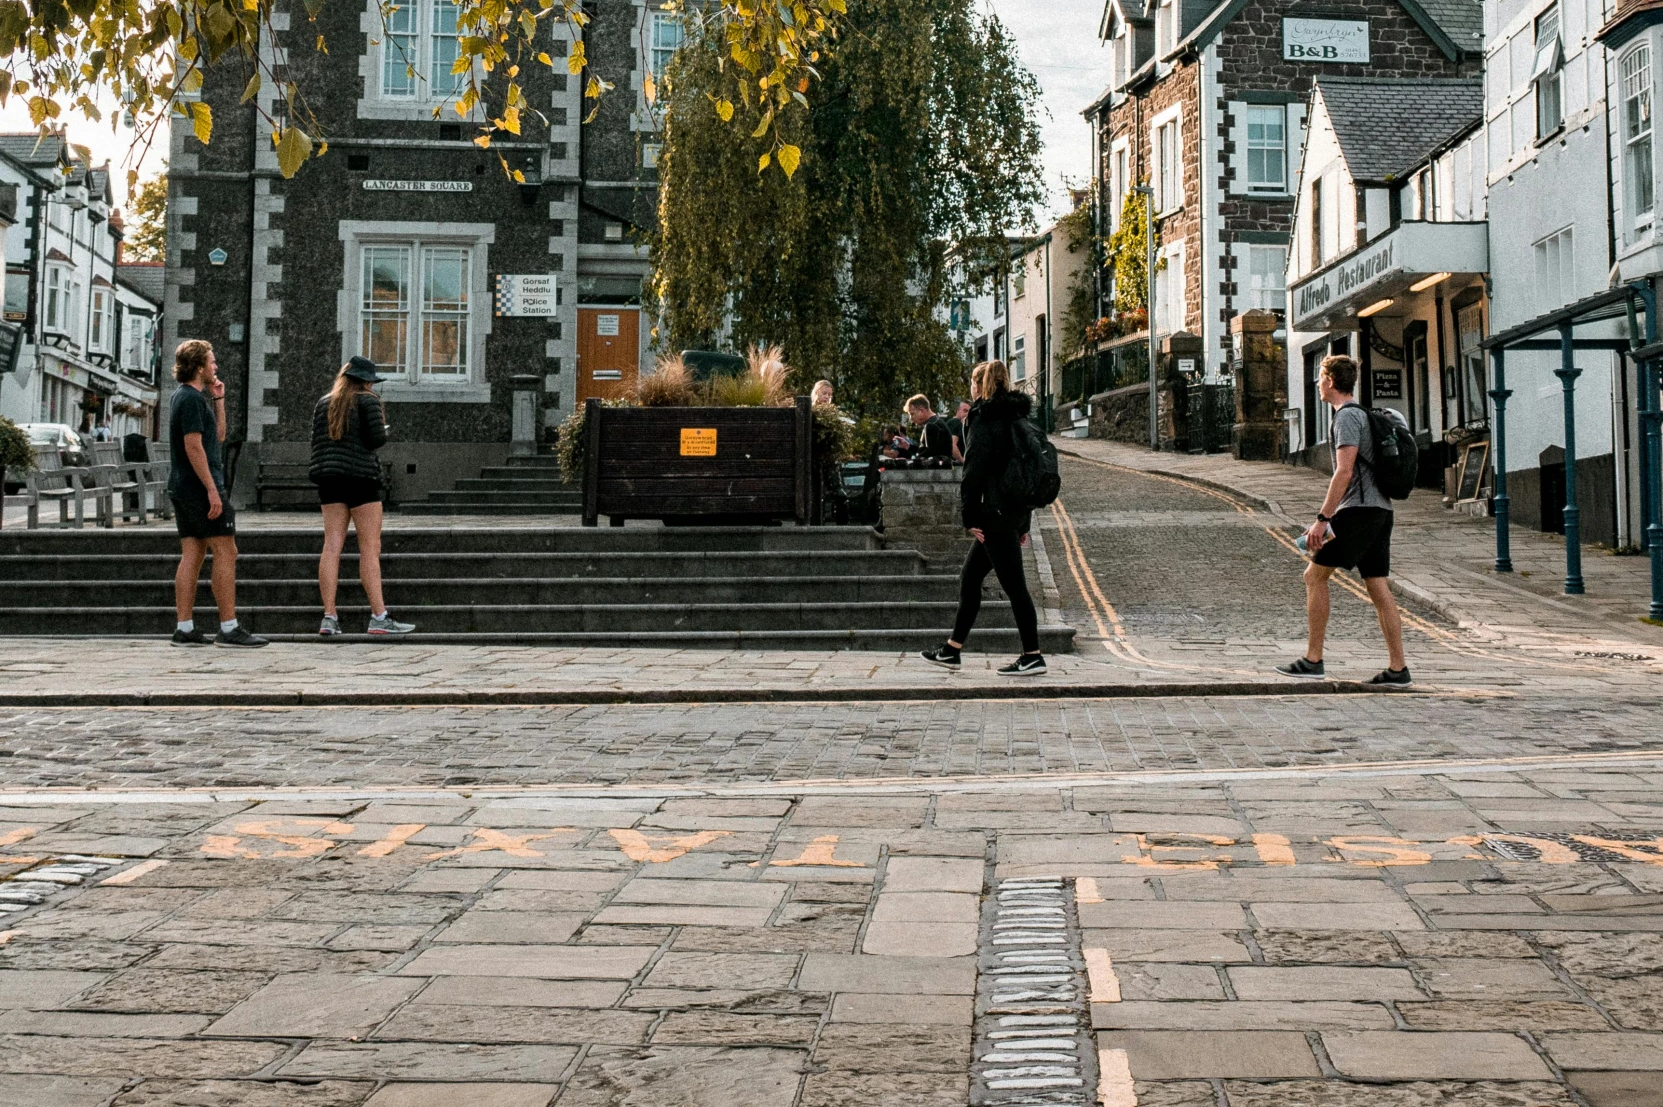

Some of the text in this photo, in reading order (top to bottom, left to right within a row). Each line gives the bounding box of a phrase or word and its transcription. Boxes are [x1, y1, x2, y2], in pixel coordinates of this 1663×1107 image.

[1288, 44, 1338, 59] B&B
[365, 181, 470, 191] LANCASTER SQUARE
[1299, 239, 1393, 316] Alfredo Restaurant
[522, 306, 551, 314] Station
[199, 820, 866, 867] TAXIS
